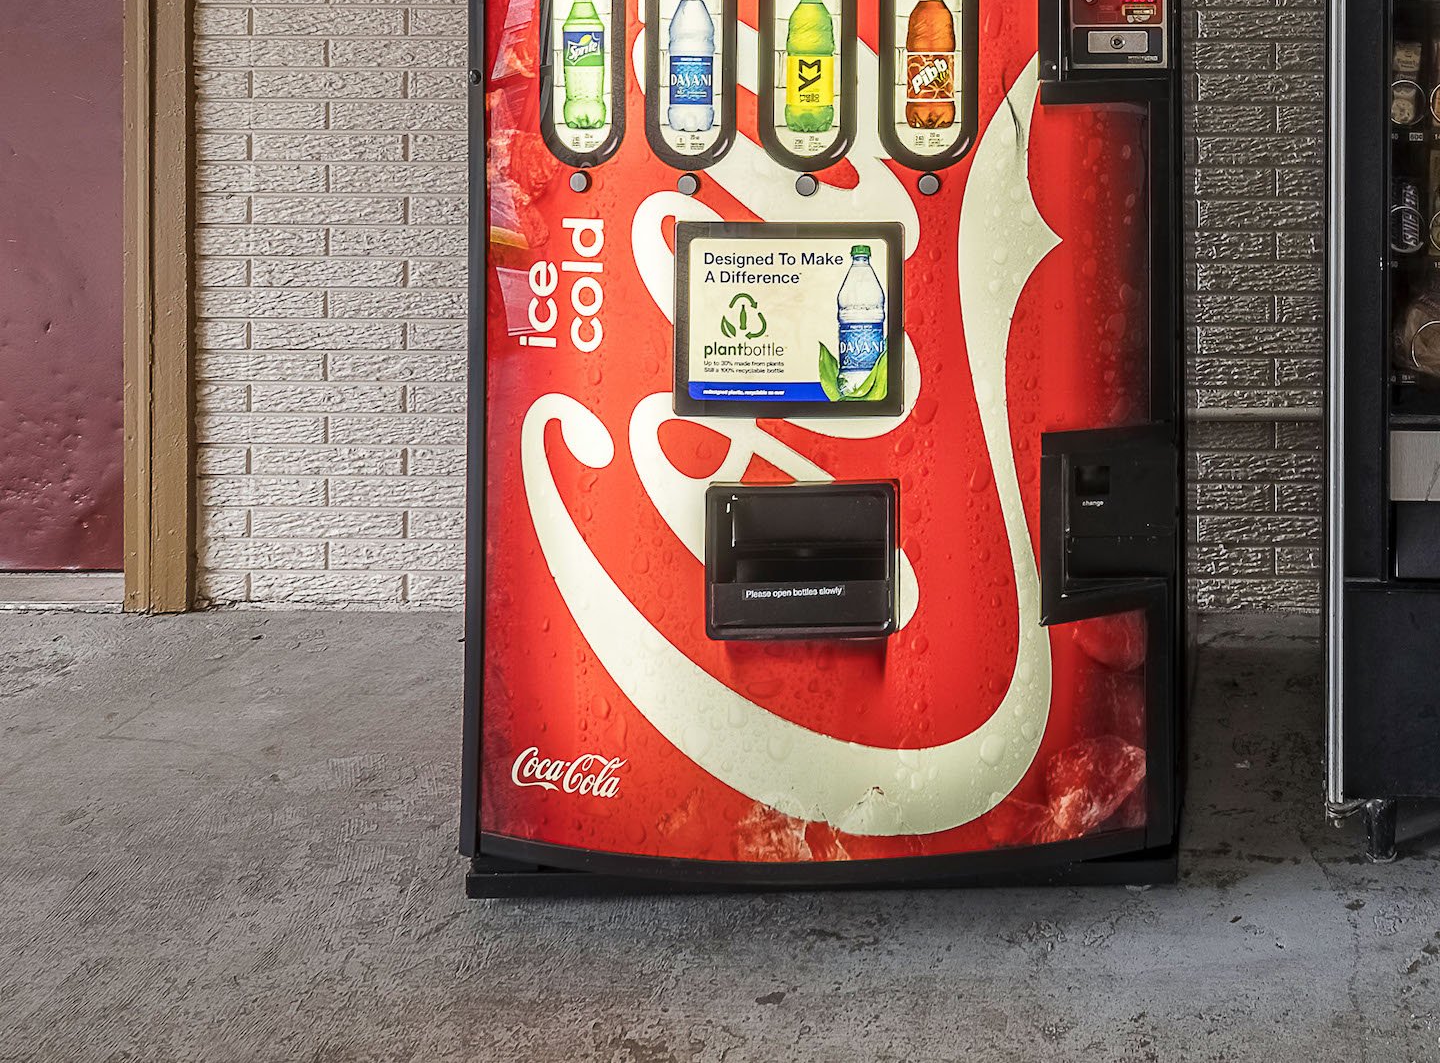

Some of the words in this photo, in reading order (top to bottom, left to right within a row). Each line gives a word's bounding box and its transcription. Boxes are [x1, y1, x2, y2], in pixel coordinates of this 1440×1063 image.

[569, 40, 599, 61] Sprite
[671, 72, 712, 88] DASANI
[704, 252, 776, 268] Designed
[778, 253, 796, 266] To
[801, 252, 844, 266] Make
[520, 260, 559, 349] ice
[562, 218, 606, 353] cold
[704, 271, 716, 284] A
[704, 342, 784, 359] plantbottle
[840, 338, 883, 354] DASANI
[1082, 500, 1104, 508] change
[746, 590, 772, 599] Please
[772, 590, 792, 599] open
[793, 587, 818, 598] bottles
[819, 587, 843, 597] slowly
[512, 746, 628, 798] Coca-Cola
